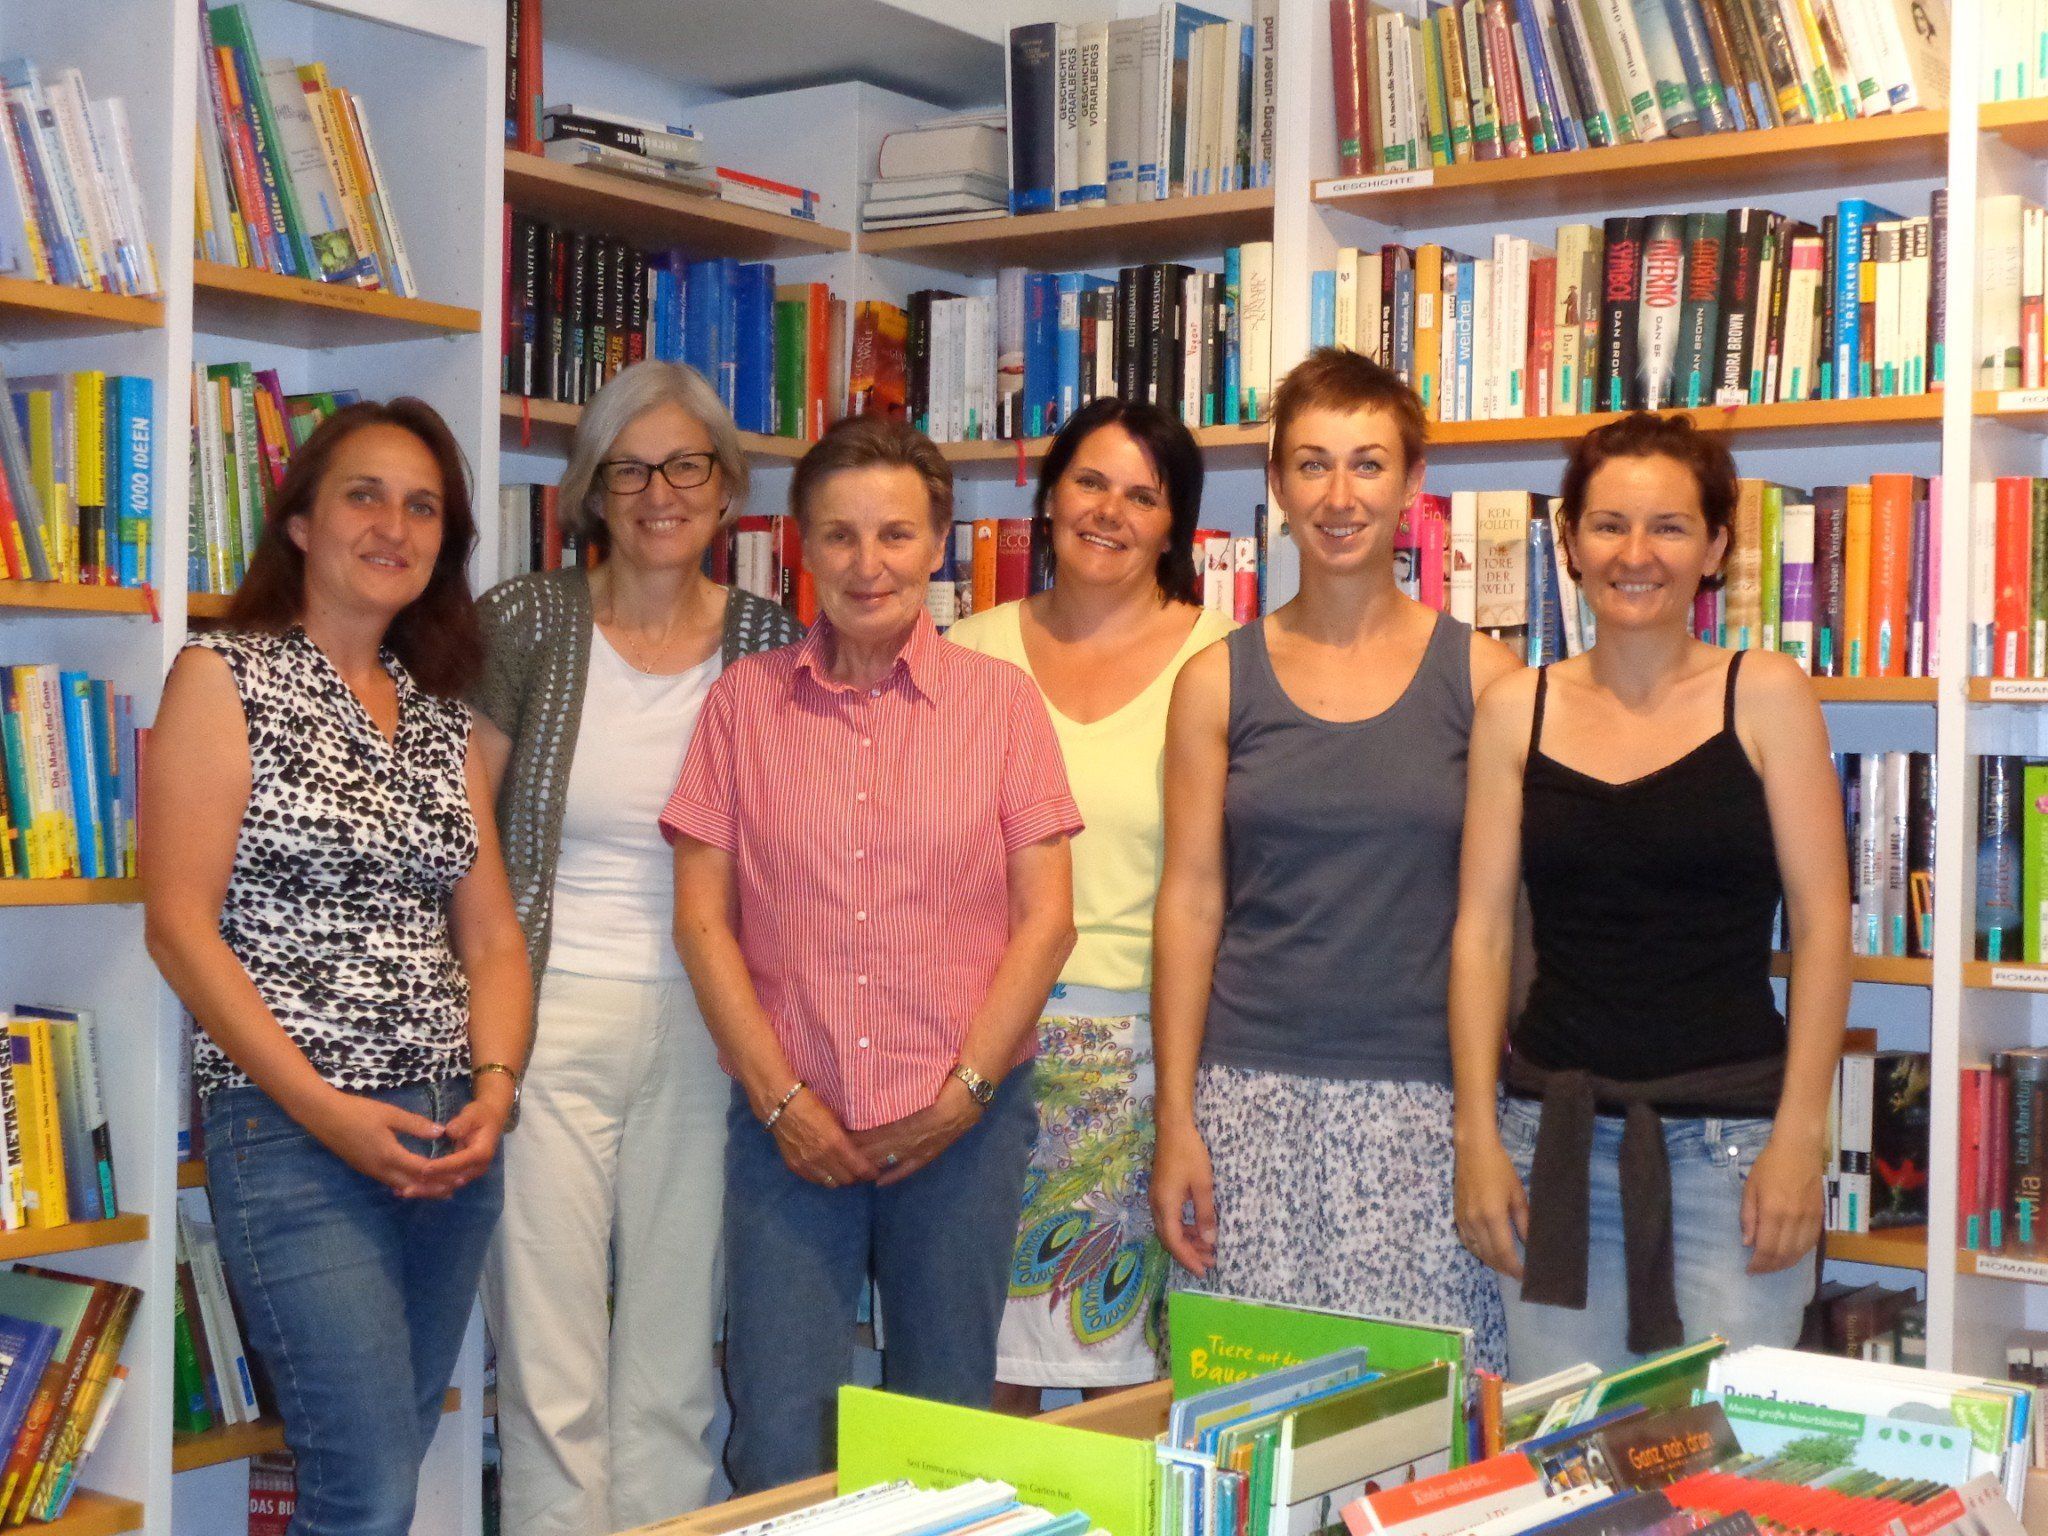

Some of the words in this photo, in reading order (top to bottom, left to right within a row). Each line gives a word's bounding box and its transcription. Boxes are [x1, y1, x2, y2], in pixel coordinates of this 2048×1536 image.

[1262, 17, 1274, 52] Land
[1262, 57, 1274, 97] unser
[1385, 50, 1394, 77] Sonne
[1059, 49, 1067, 121] GESCHICHTE
[1068, 47, 1077, 130] VORARLBERGS
[1081, 45, 1090, 117] GESCHICHTE
[1090, 43, 1099, 127] VORARLBERGS
[1386, 78, 1395, 92] die
[1387, 91, 1397, 113] noch
[1388, 115, 1398, 130] Als
[261, 156, 276, 187] der
[1333, 175, 1415, 193] GESCHICHTE
[1847, 211, 1857, 255] HILFT
[1863, 234, 1872, 261] PIPER
[1917, 225, 1926, 256] PIPER
[526, 225, 536, 307] ERWARTUNG
[1645, 238, 1683, 309] INFERNO
[596, 249, 606, 319] ERBARMEN
[615, 246, 625, 330] VERACHTUNG
[632, 260, 642, 327] ERLÖSUNG
[1845, 262, 1856, 329] TRINKEN
[1152, 270, 1162, 332] VERWESUNG
[1458, 299, 1472, 360] weichei
[1614, 310, 1623, 338] DAN
[1654, 316, 1664, 341] DAN
[1694, 307, 1704, 350] BROWN
[1727, 314, 1745, 351] BROWN
[1612, 341, 1622, 376] BROW
[1725, 352, 1743, 391] SANDRA
[131, 416, 150, 470] IDEEN
[131, 472, 150, 515] 1000
[1479, 518, 1522, 530] FOLLETT
[1487, 507, 1511, 519] KEN
[998, 534, 1030, 548] ECO
[1829, 507, 1841, 559] Verdacht
[1483, 558, 1514, 569] TORE
[1485, 571, 1511, 582] DER
[1829, 562, 1840, 593] böser
[1481, 583, 1517, 595] WELT
[1829, 595, 1839, 615] Ein
[41, 680, 53, 710] Gene
[43, 712, 54, 731] der
[44, 732, 60, 768] Macht
[49, 769, 61, 789] Die
[1889, 833, 1899, 860] JAMES
[1889, 866, 1899, 890] PETER
[0, 1026, 21, 1166] METASTASEN
[2016, 1067, 2032, 1134] Marklund
[2015, 1137, 2029, 1165] Liza
[1208, 1334, 1253, 1360] Tiere
[1257, 1351, 1280, 1367] auf
[1728, 1401, 1757, 1415] Meine
[1758, 1406, 1787, 1420] große
[1788, 1411, 1860, 1431] Naturbibliothek
[1628, 1446, 1664, 1469] Ganz
[1662, 1436, 1688, 1460] nah
[1686, 1431, 1715, 1455] dran
[250, 1498, 274, 1514] DAS
[1029, 1483, 1057, 1498] Garten
[1057, 1489, 1072, 1502] hat,
